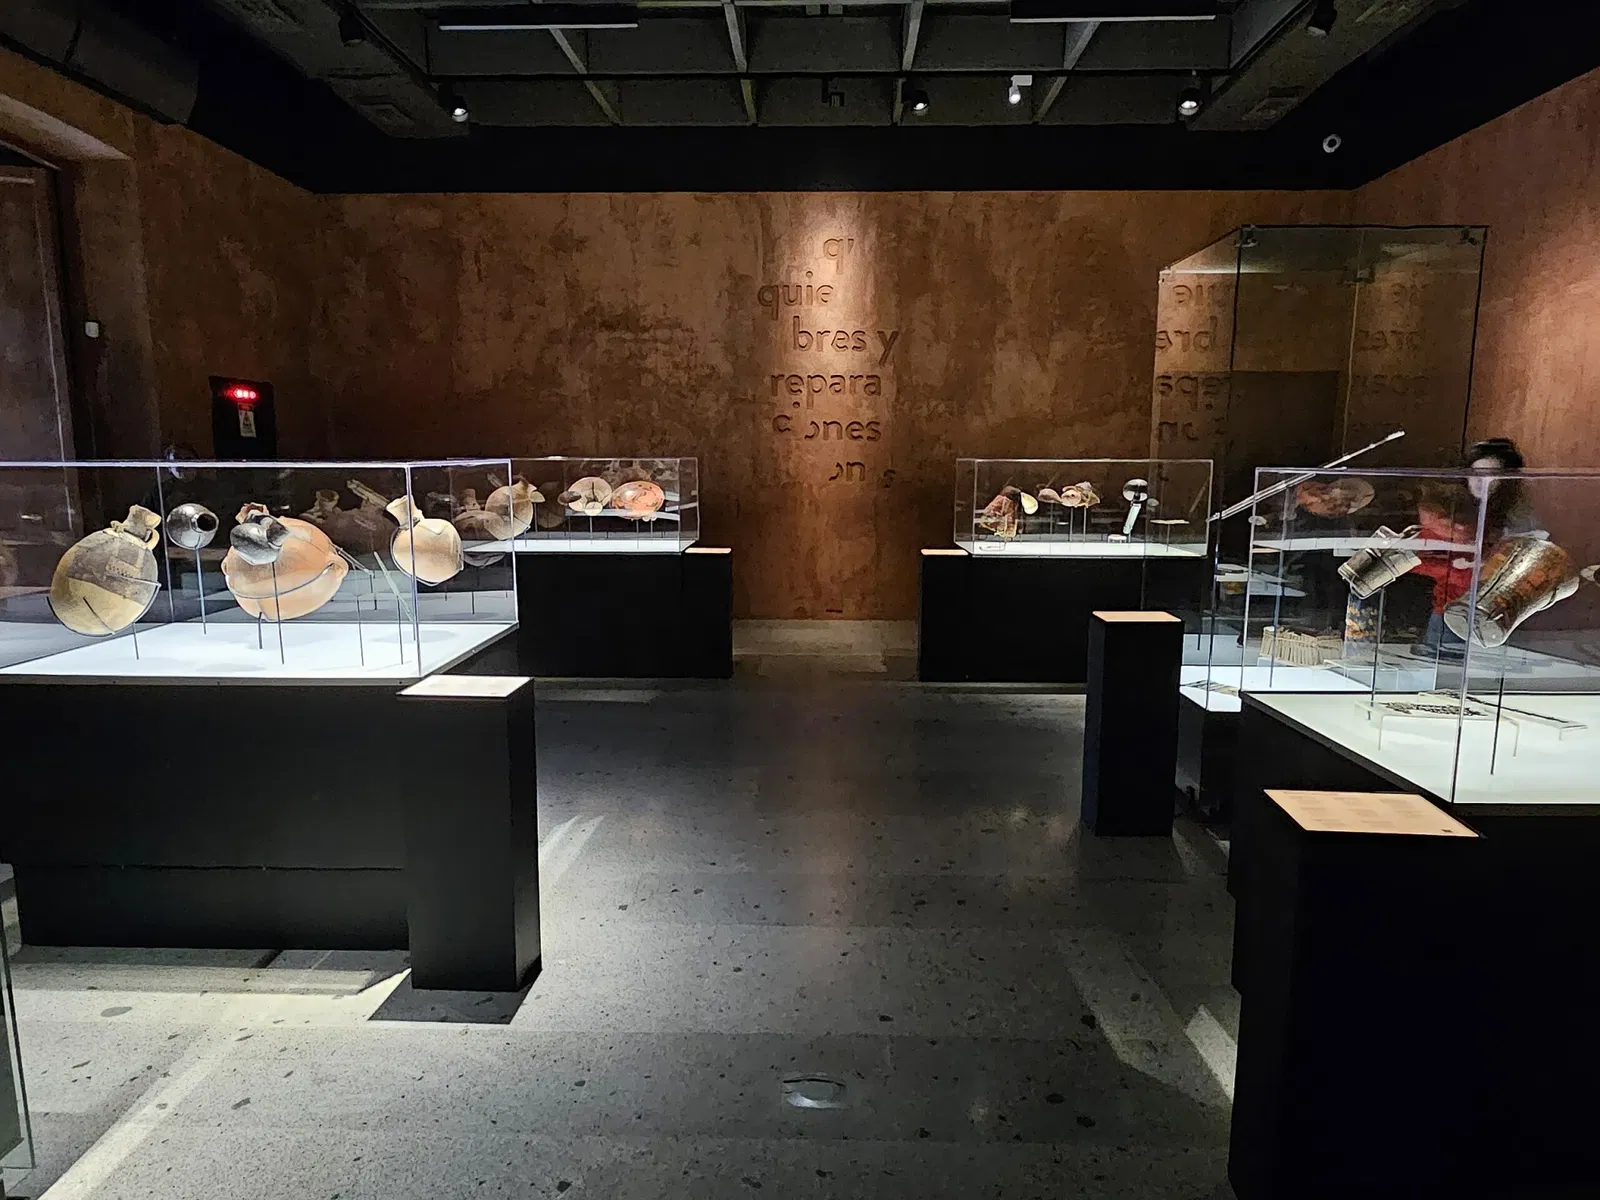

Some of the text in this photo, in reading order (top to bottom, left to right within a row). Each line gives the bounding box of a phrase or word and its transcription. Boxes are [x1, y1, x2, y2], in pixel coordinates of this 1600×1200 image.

[793, 316, 899, 366] bres y
[770, 373, 882, 410] repara
